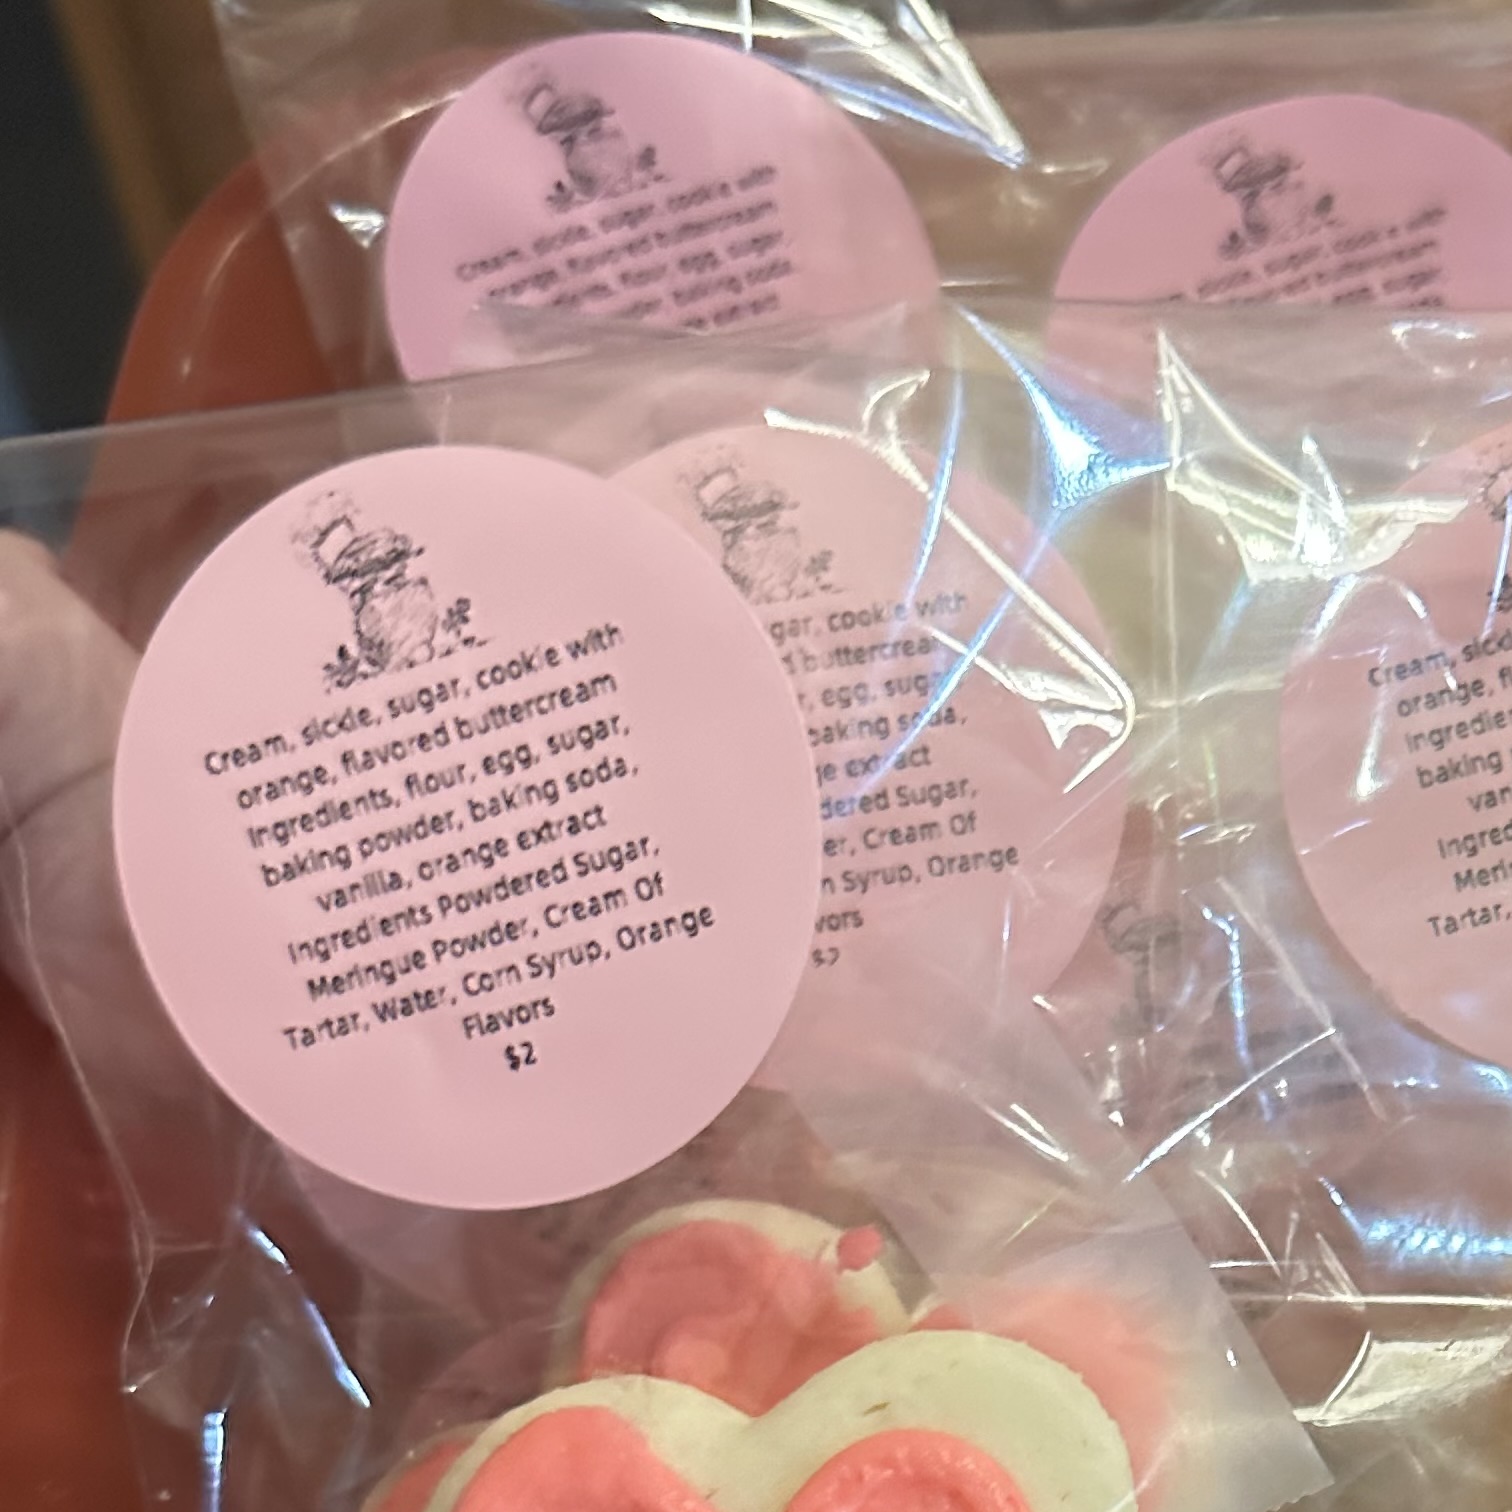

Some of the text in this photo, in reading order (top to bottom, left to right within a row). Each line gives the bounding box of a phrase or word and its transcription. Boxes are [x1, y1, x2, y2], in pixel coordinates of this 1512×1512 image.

[766, 616, 821, 648] gar,
[800, 636, 937, 673] buttercrea
[1367, 651, 1458, 689] Cream,
[204, 623, 621, 777] Cream, sickle, sugar, cookie with
[1396, 678, 1495, 719] orange,
[236, 673, 618, 811] orange, flavored buttercream
[403, 763, 478, 801] flour,
[481, 743, 541, 777] egg,
[546, 715, 631, 757] sugar,
[1415, 750, 1505, 790] baking
[895, 777, 979, 809] Sugar,
[260, 756, 639, 889] baking powder, baking soda,
[861, 821, 943, 852] Cream
[949, 810, 978, 837] Of
[315, 804, 608, 913] vanilla, orange extract
[840, 863, 923, 895] Syrup,
[926, 846, 1020, 878] Orange
[287, 836, 660, 965] Ingredients Powdered Sugar,
[814, 909, 865, 935] vors
[1426, 903, 1512, 938] Tartar,
[306, 870, 665, 1002] Meringue Powder, Cream Of
[282, 906, 715, 1051] Tartar, Water, Corn Syrup, Orange
[462, 996, 556, 1041] Flavors
[504, 1041, 538, 1072] $2
